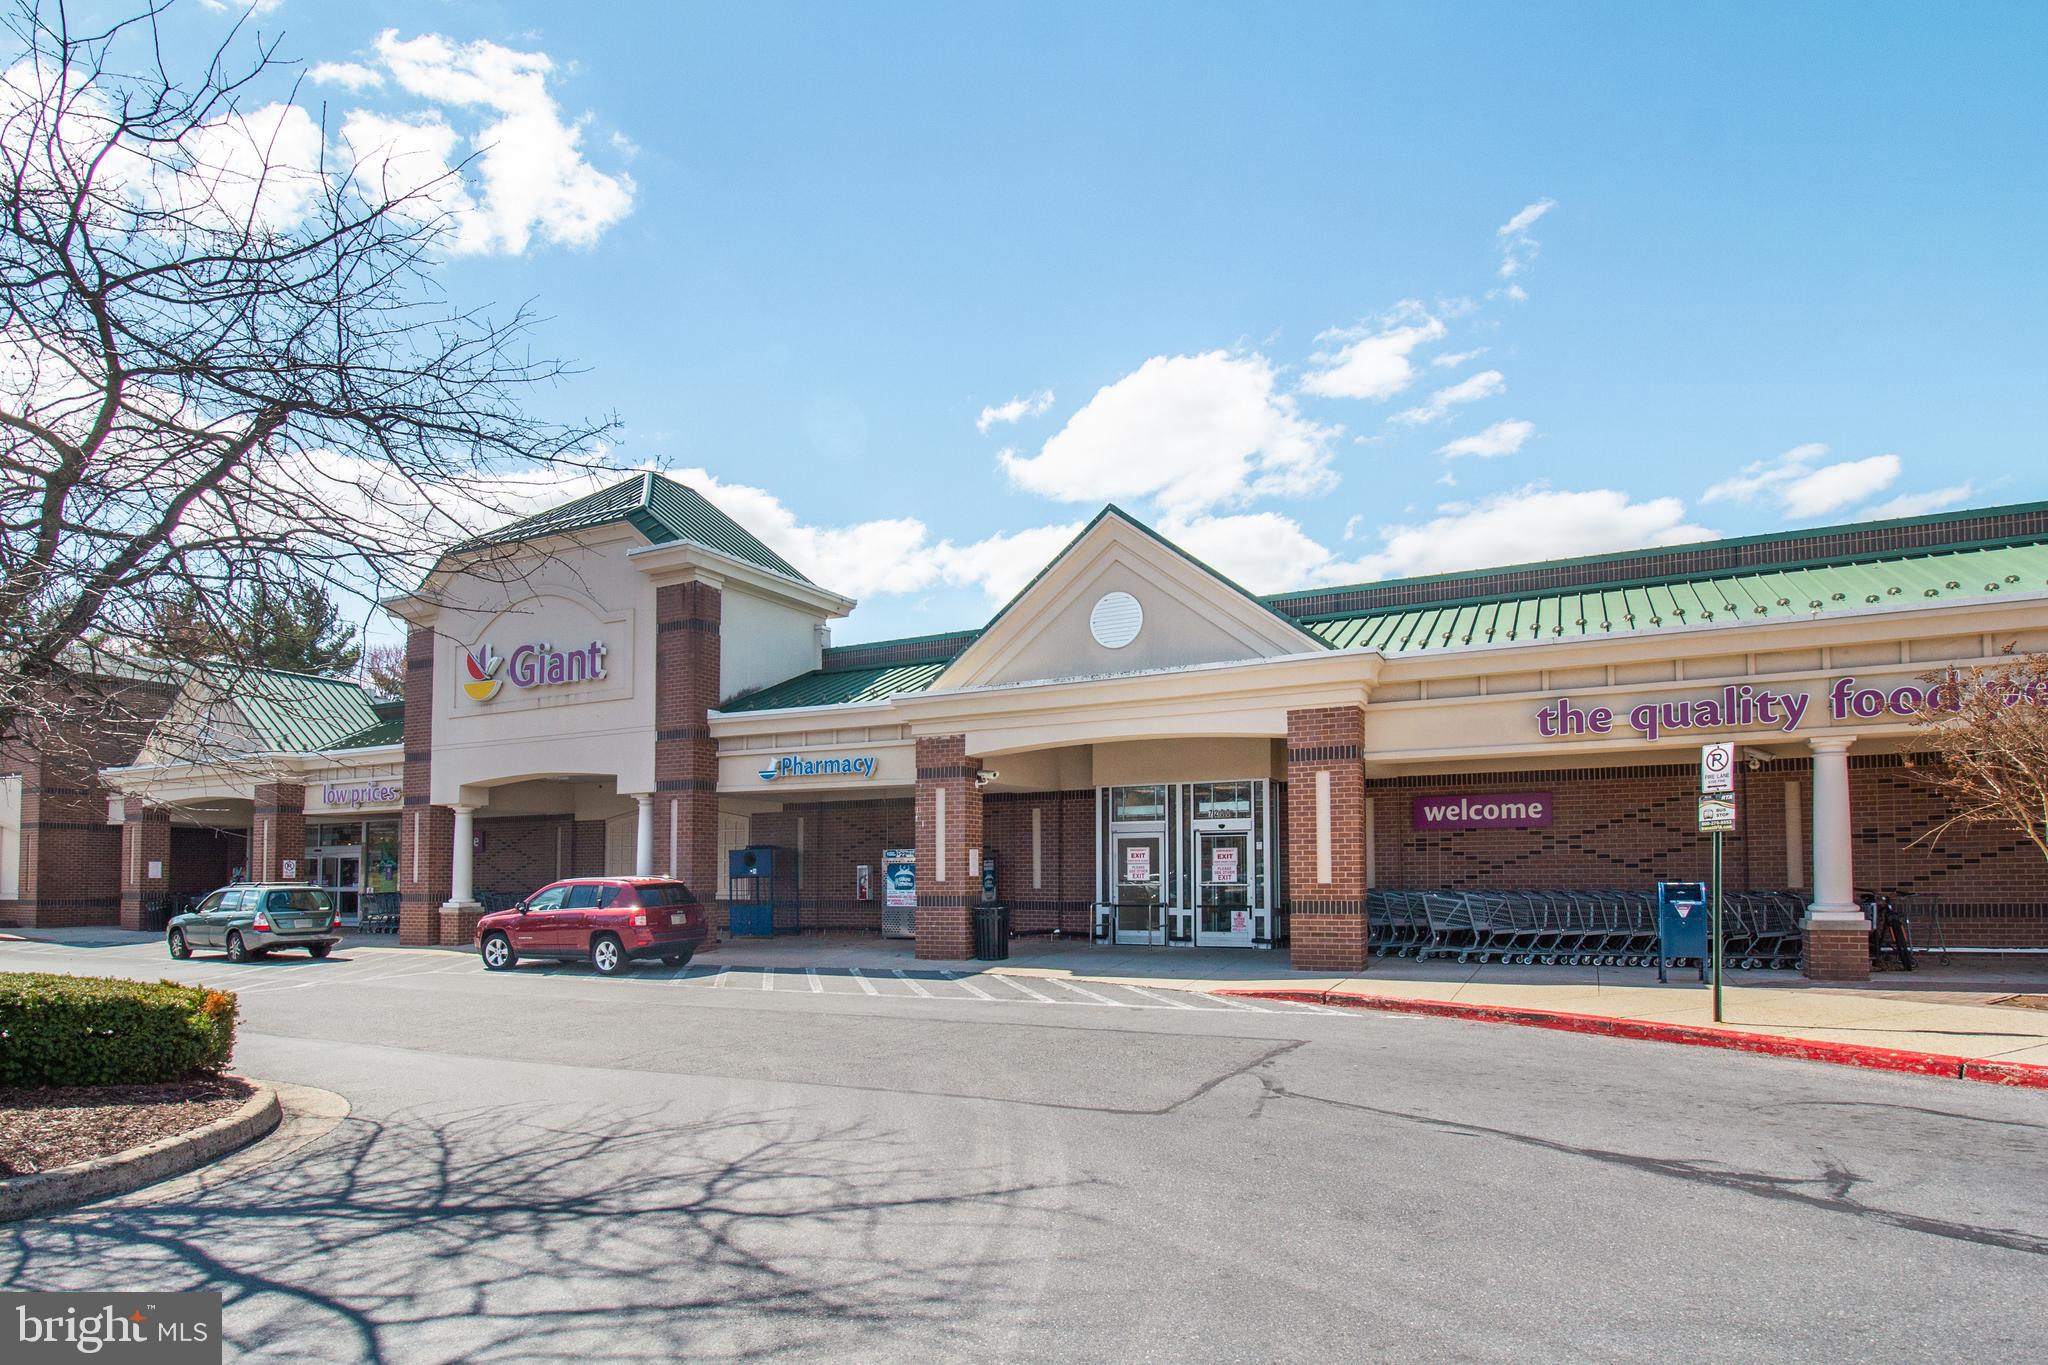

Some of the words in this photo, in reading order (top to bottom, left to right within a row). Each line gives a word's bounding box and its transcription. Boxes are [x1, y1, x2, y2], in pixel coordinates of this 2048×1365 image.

[509, 641, 606, 688] Giant
[1536, 698, 1613, 737] the
[1630, 685, 1809, 741] quality
[780, 754, 875, 778] Pharmacy
[322, 783, 347, 805] low
[351, 781, 397, 808] prices
[1423, 798, 1543, 822] welcome
